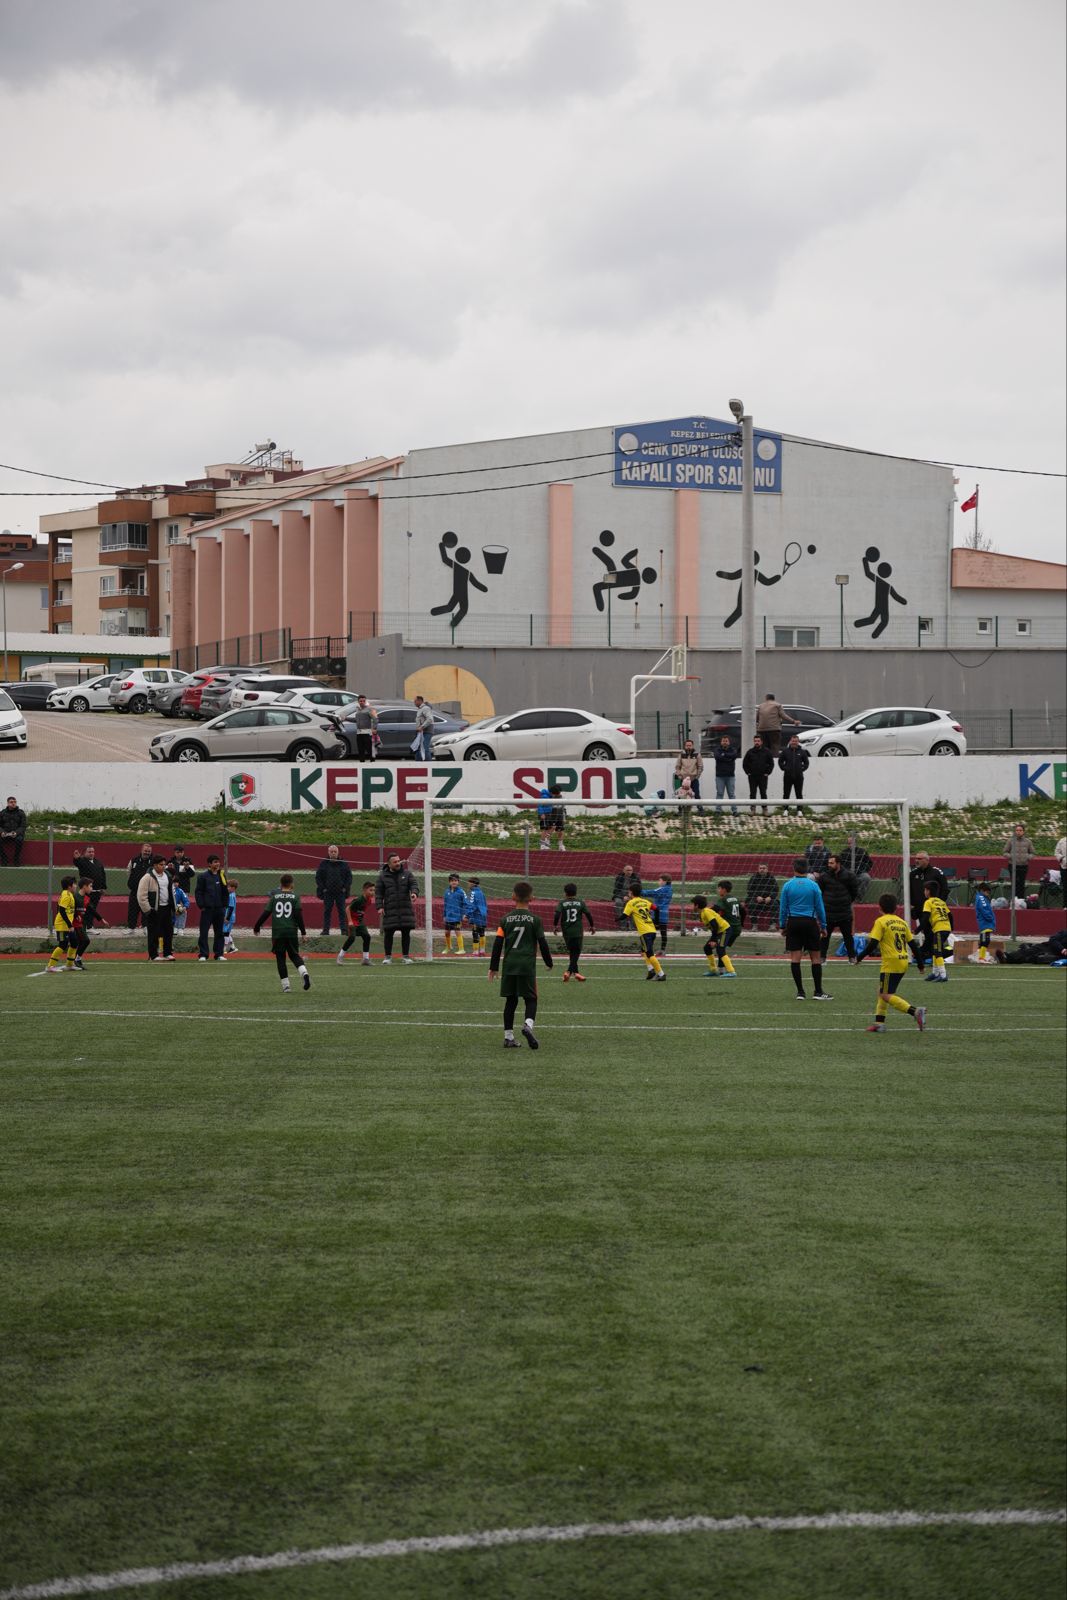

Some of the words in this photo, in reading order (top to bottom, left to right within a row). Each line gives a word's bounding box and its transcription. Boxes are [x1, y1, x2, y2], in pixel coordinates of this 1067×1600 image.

[670, 430, 694, 439] KEPEZ
[641, 442, 669, 456] CENK
[621, 461, 672, 483] KAPALI
[675, 463, 714, 485] SPOR
[718, 465, 775, 488] SALNU
[290, 767, 463, 811] KEPEZ
[512, 766, 647, 810] SPOR
[275, 901, 292, 918] 99
[566, 908, 578, 923] 13
[511, 926, 525, 949] 7
